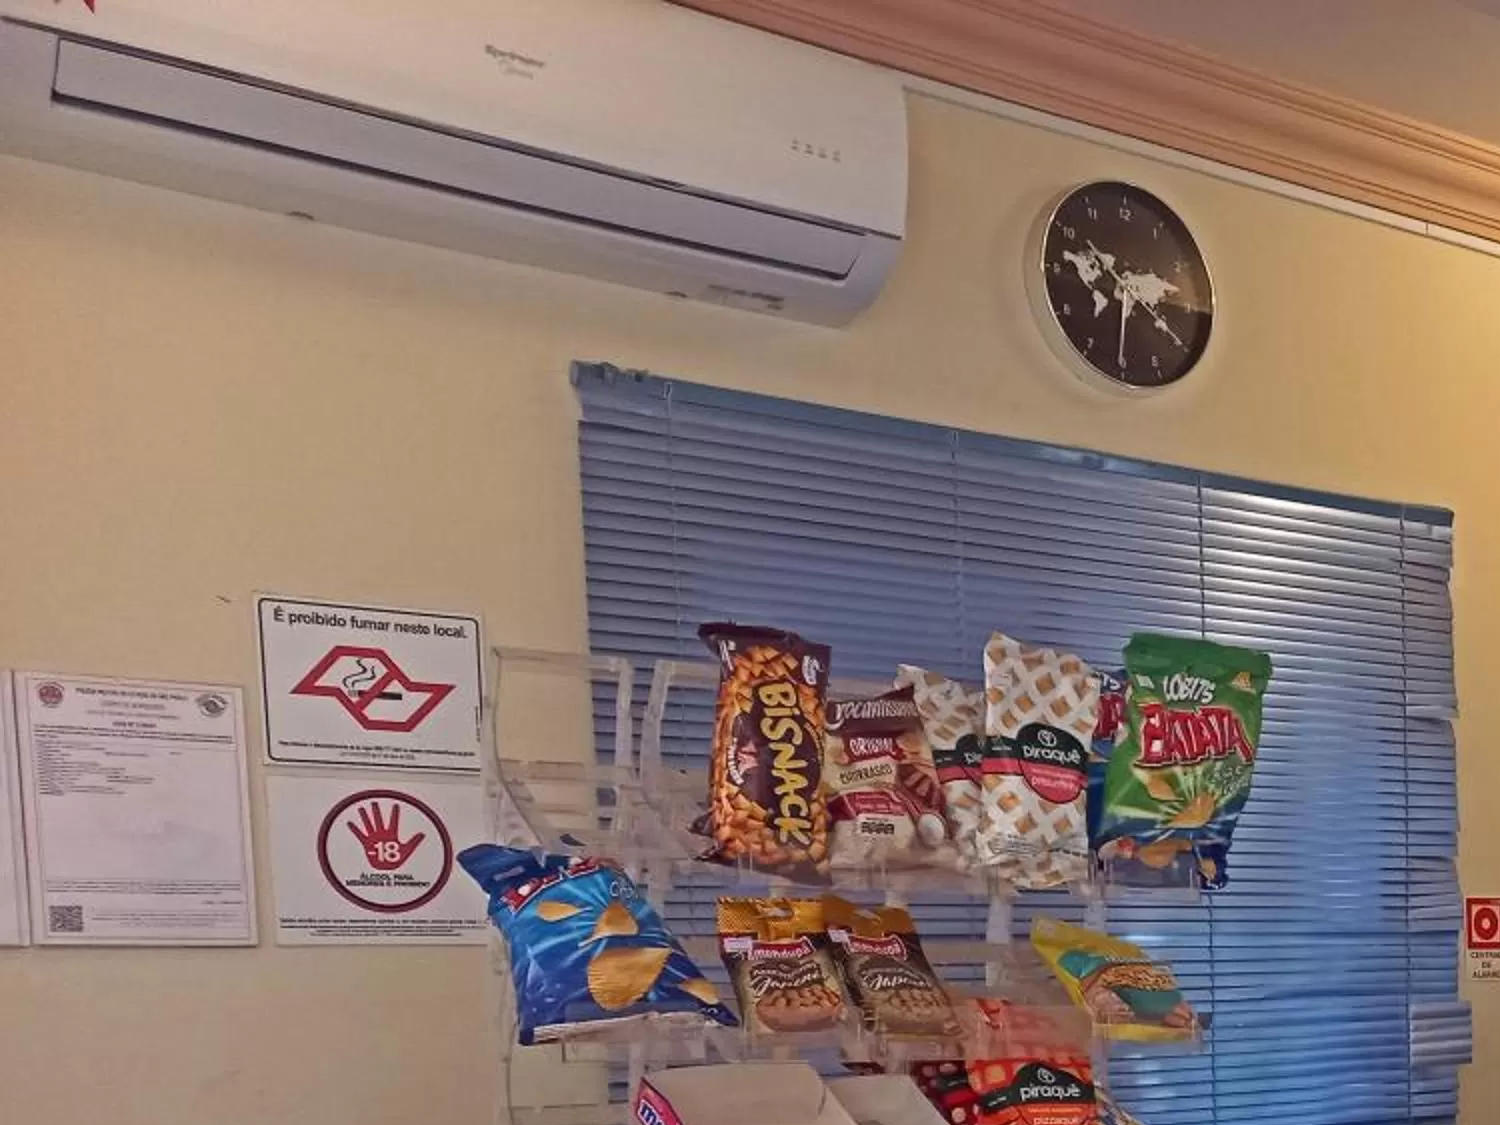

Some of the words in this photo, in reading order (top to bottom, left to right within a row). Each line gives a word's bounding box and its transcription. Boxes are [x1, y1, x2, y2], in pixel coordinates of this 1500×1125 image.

[1087, 208, 1098, 220] 11
[1119, 208, 1131, 221] 12
[1063, 226, 1075, 239] 10
[273, 606, 285, 622] É
[288, 610, 347, 628] proibido
[350, 616, 391, 632] fumar
[394, 623, 431, 636] neste
[433, 625, 468, 639] local.
[1022, 745, 1081, 766] piraquê
[368, 841, 401, 863] -18
[1020, 1082, 1081, 1102] piraquê
